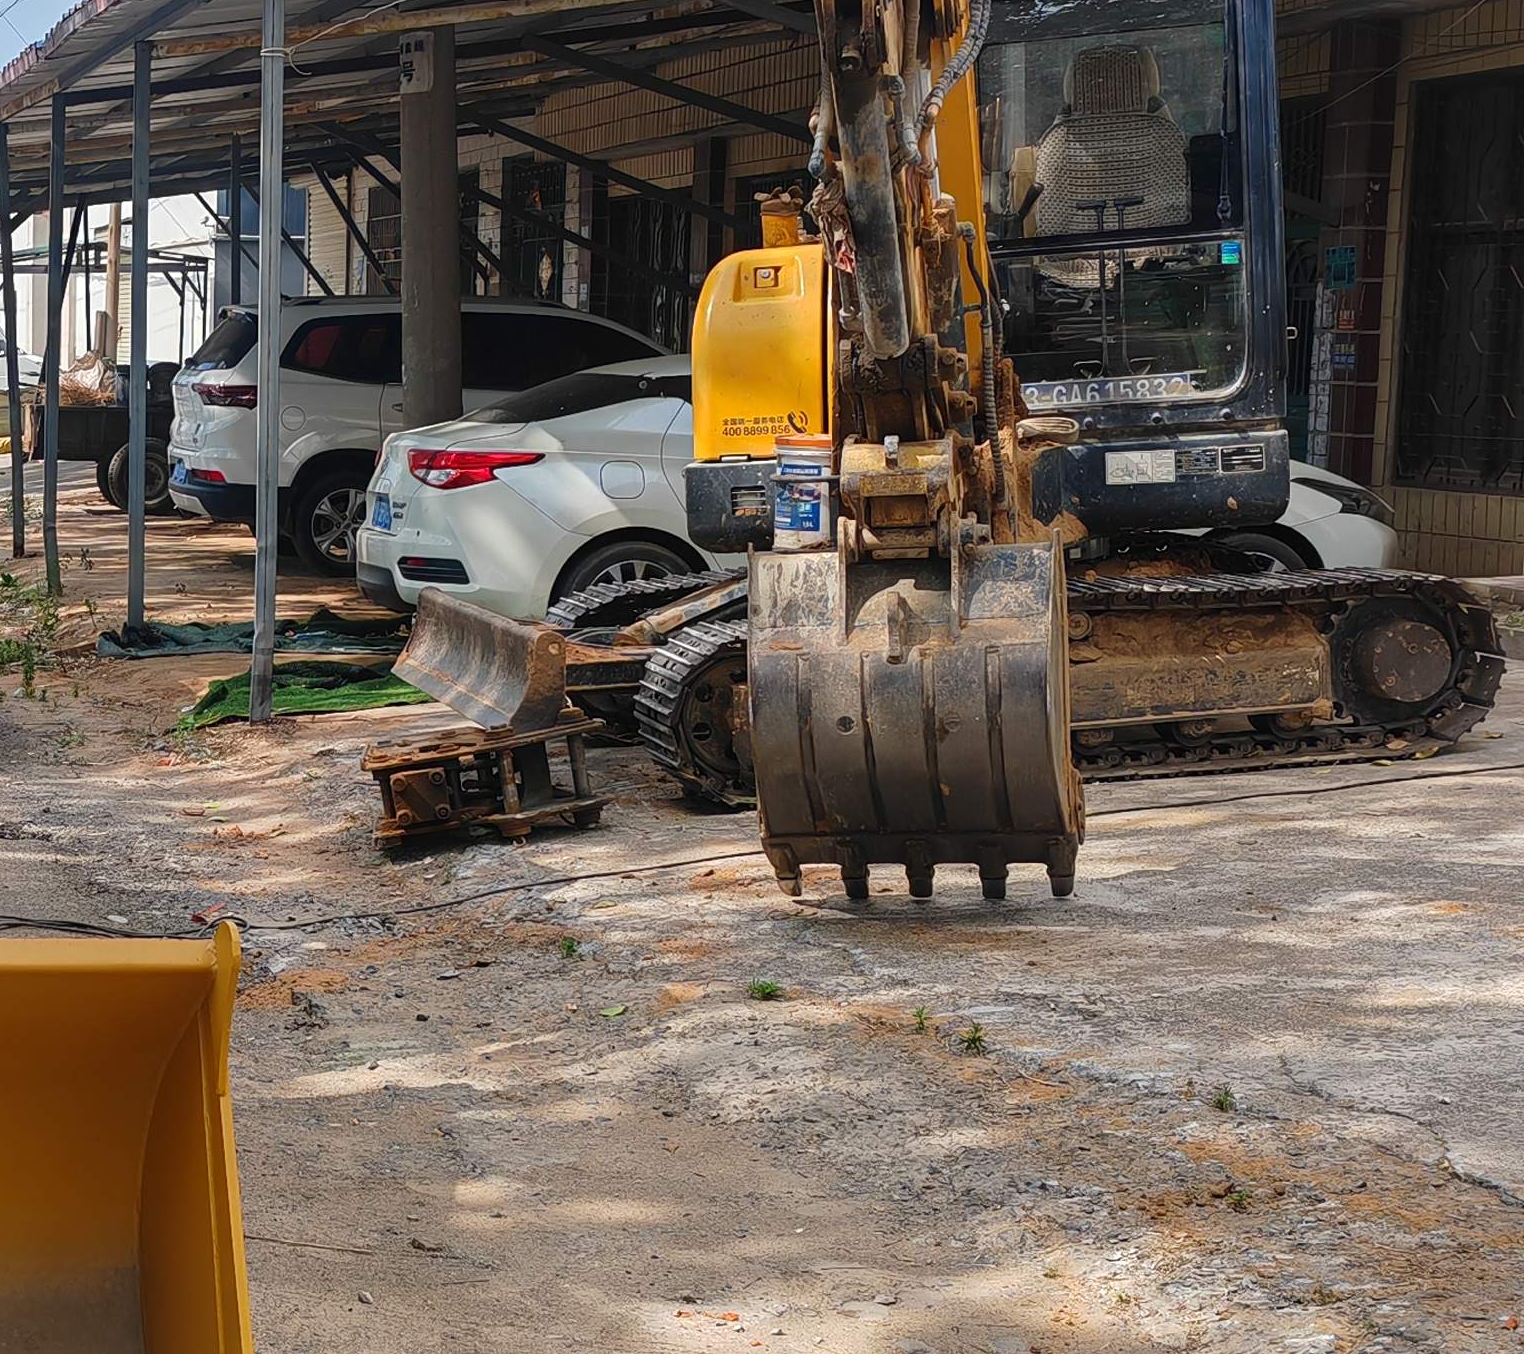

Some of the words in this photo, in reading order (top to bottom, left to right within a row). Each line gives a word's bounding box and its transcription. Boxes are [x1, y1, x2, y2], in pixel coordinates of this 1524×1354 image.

[722, 426, 742, 437] 400
[743, 425, 769, 436] 8899
[771, 424, 790, 435] 856
